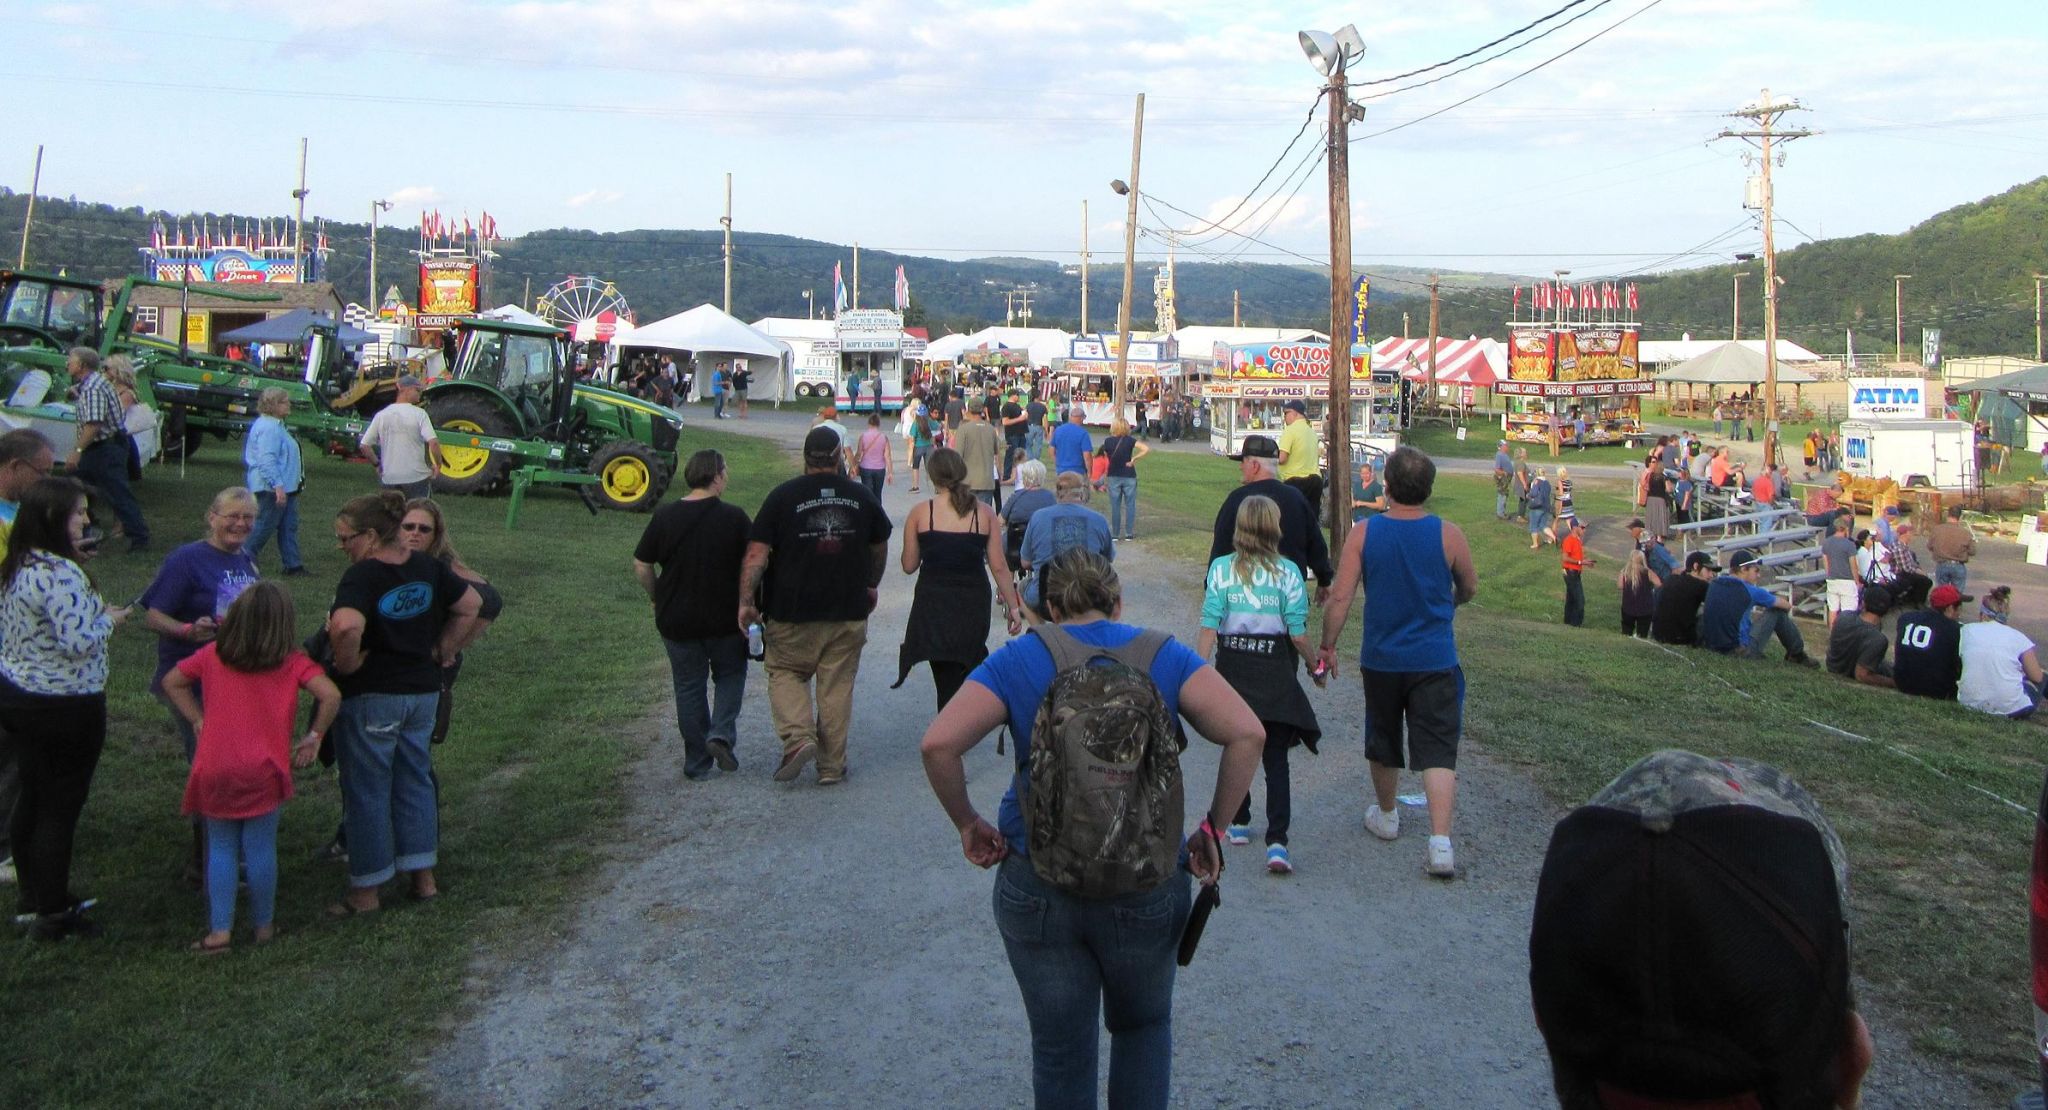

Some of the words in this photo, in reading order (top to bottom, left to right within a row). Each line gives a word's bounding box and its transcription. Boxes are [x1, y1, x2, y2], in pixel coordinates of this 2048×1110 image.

[222, 271, 258, 282] Diner
[419, 316, 447, 325] CHICKEN
[1575, 331, 1600, 340] FUNNEL
[1601, 331, 1621, 339] CAKES
[846, 341, 862, 349] SOFT
[1268, 345, 1331, 361] COTTON
[1273, 361, 1330, 377] CANDY
[1244, 387, 1271, 398] Candy
[1271, 388, 1304, 396] APPLES
[1349, 388, 1371, 396] PLES
[1498, 384, 1520, 393] FUNNEL
[1522, 384, 1540, 394] CAKES
[1544, 387, 1573, 395] OREOS
[1576, 384, 1596, 394] FUNNEL
[1597, 384, 1614, 393] CAKES
[1618, 383, 1626, 392] ICE
[1626, 382, 1637, 392] COLD
[1637, 382, 1653, 392] DRINKS
[1853, 388, 1919, 404] ATM
[1846, 438, 1866, 459] ATM
[393, 588, 427, 612] Ford
[1227, 593, 1246, 604] EST.
[1260, 595, 1280, 606] 1850
[1901, 623, 1932, 648] 10
